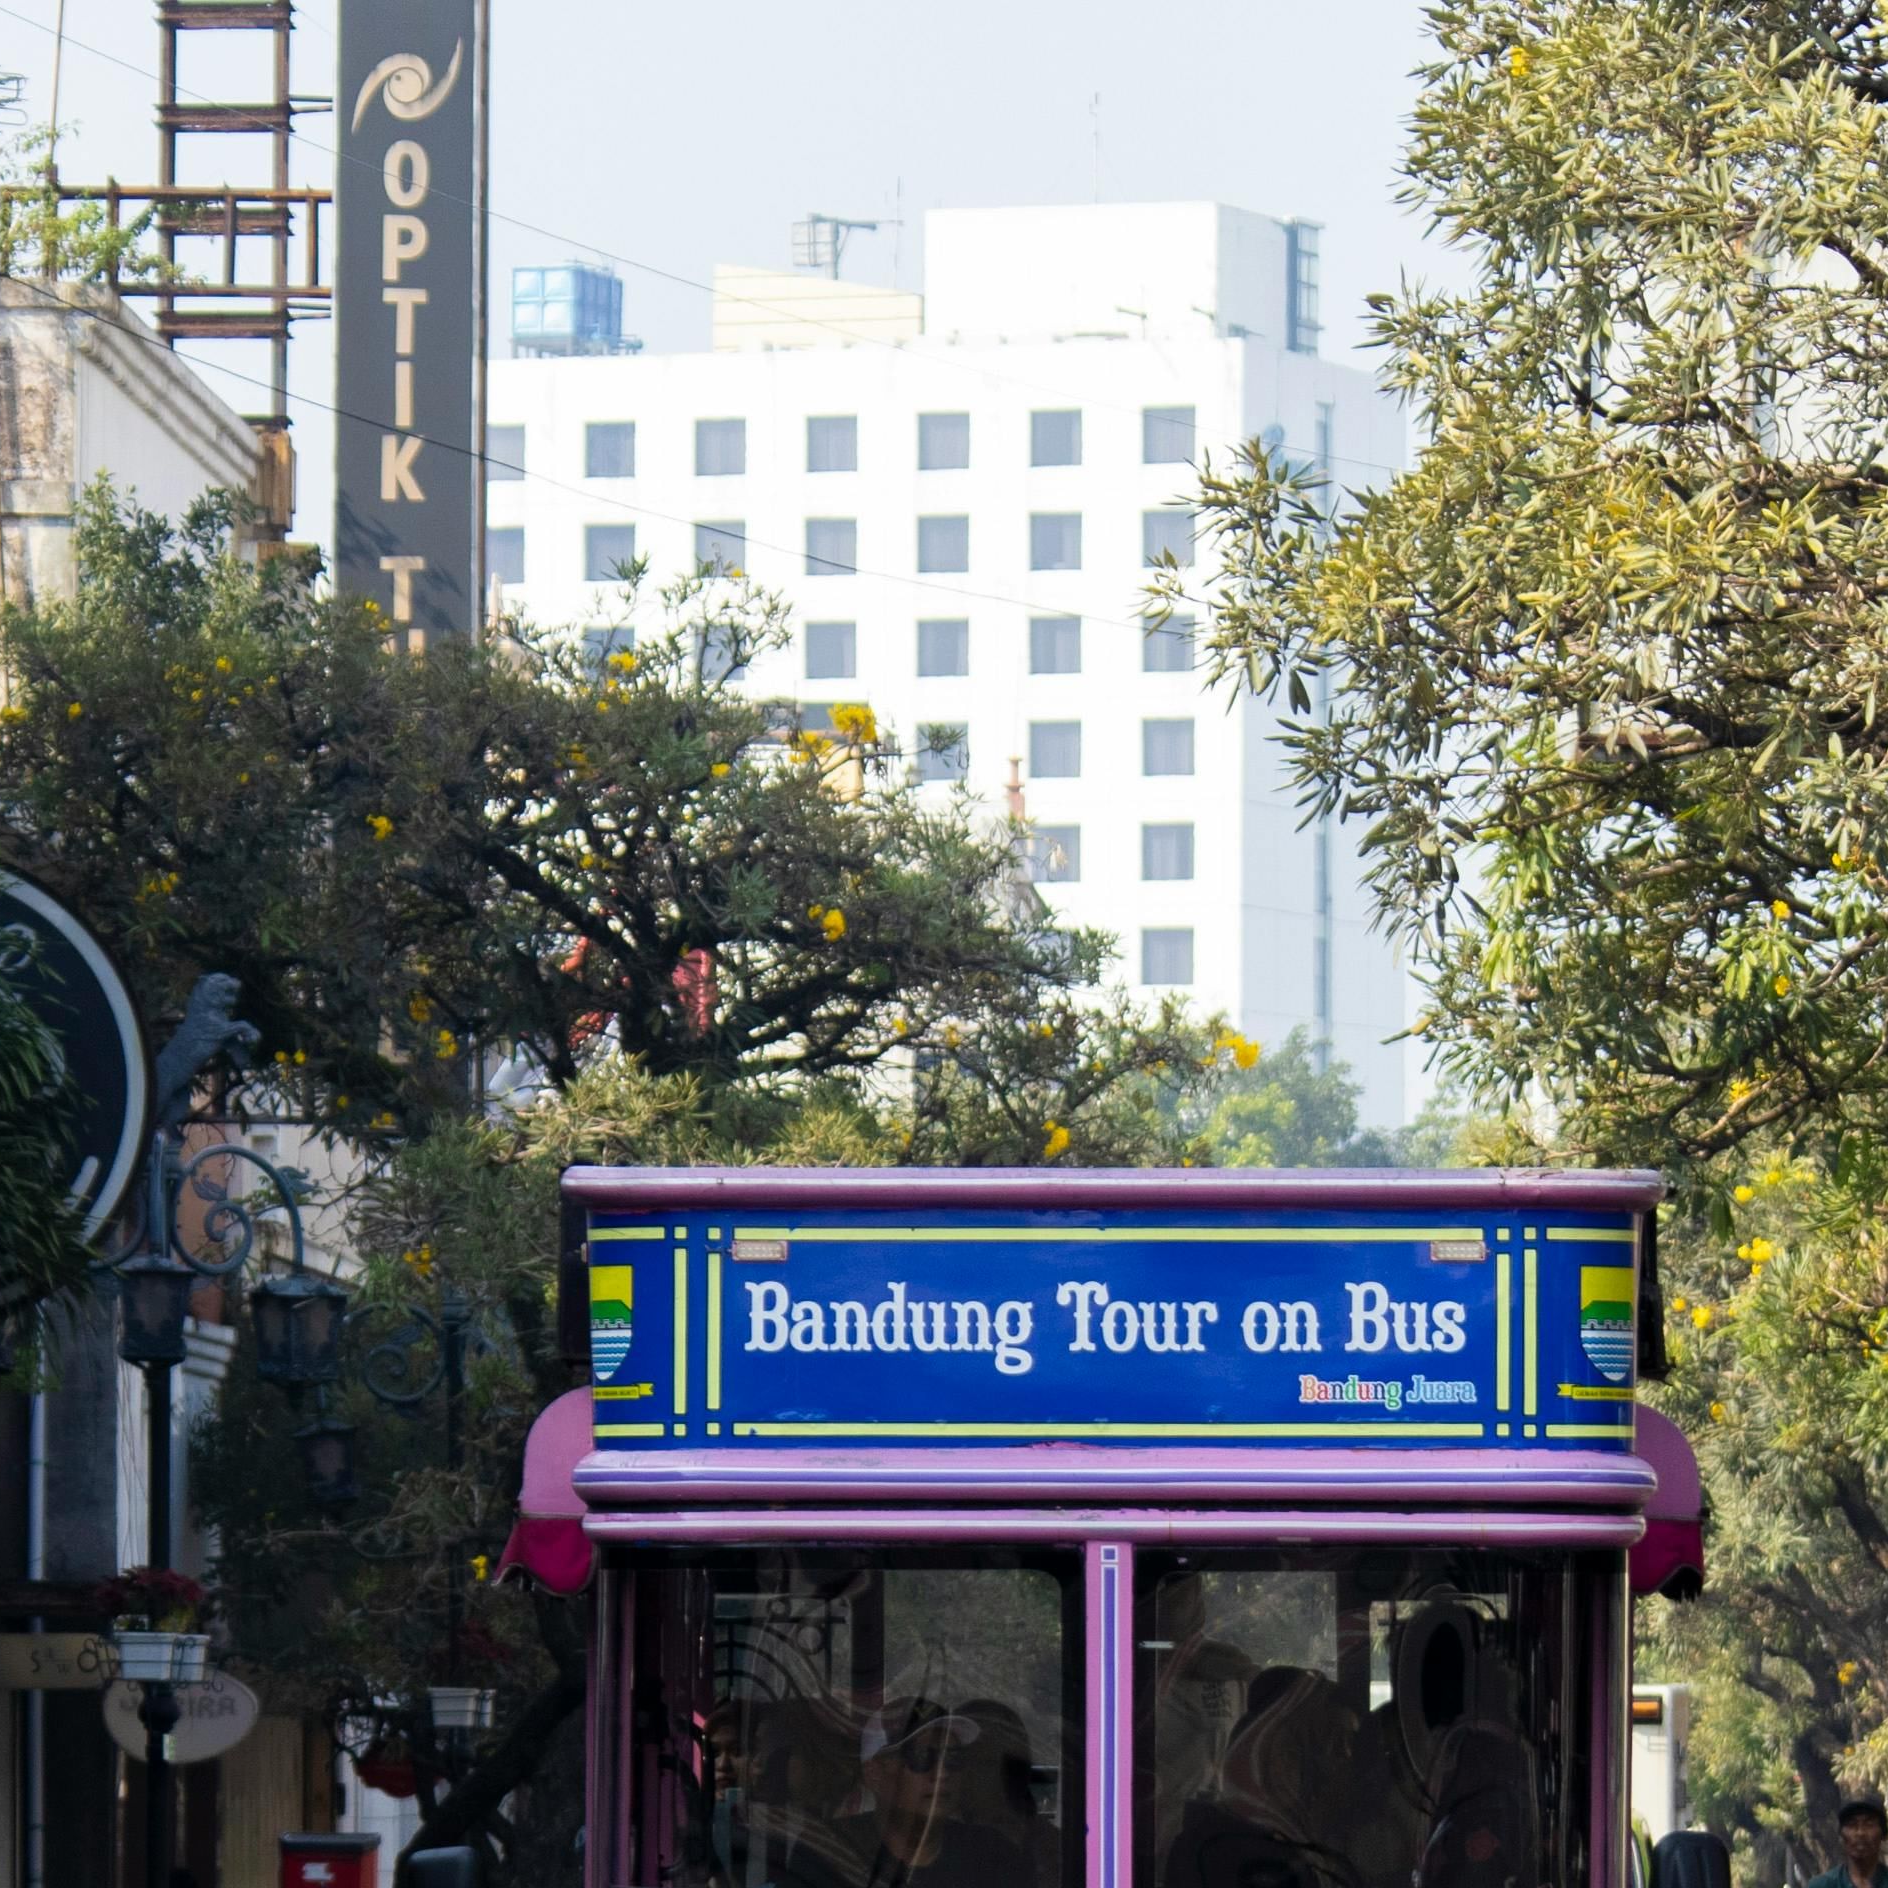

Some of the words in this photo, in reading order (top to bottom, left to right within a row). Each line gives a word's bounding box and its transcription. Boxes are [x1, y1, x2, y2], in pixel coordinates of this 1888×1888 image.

[380, 139, 430, 502] OPTIK
[743, 1279, 1034, 1375] Bandung
[1055, 1279, 1219, 1354] Tour
[1240, 1299, 1322, 1354] on
[1344, 1279, 1468, 1354] Bus
[1298, 1374, 1403, 1411] Bandung
[1405, 1374, 1479, 1404] Juara
